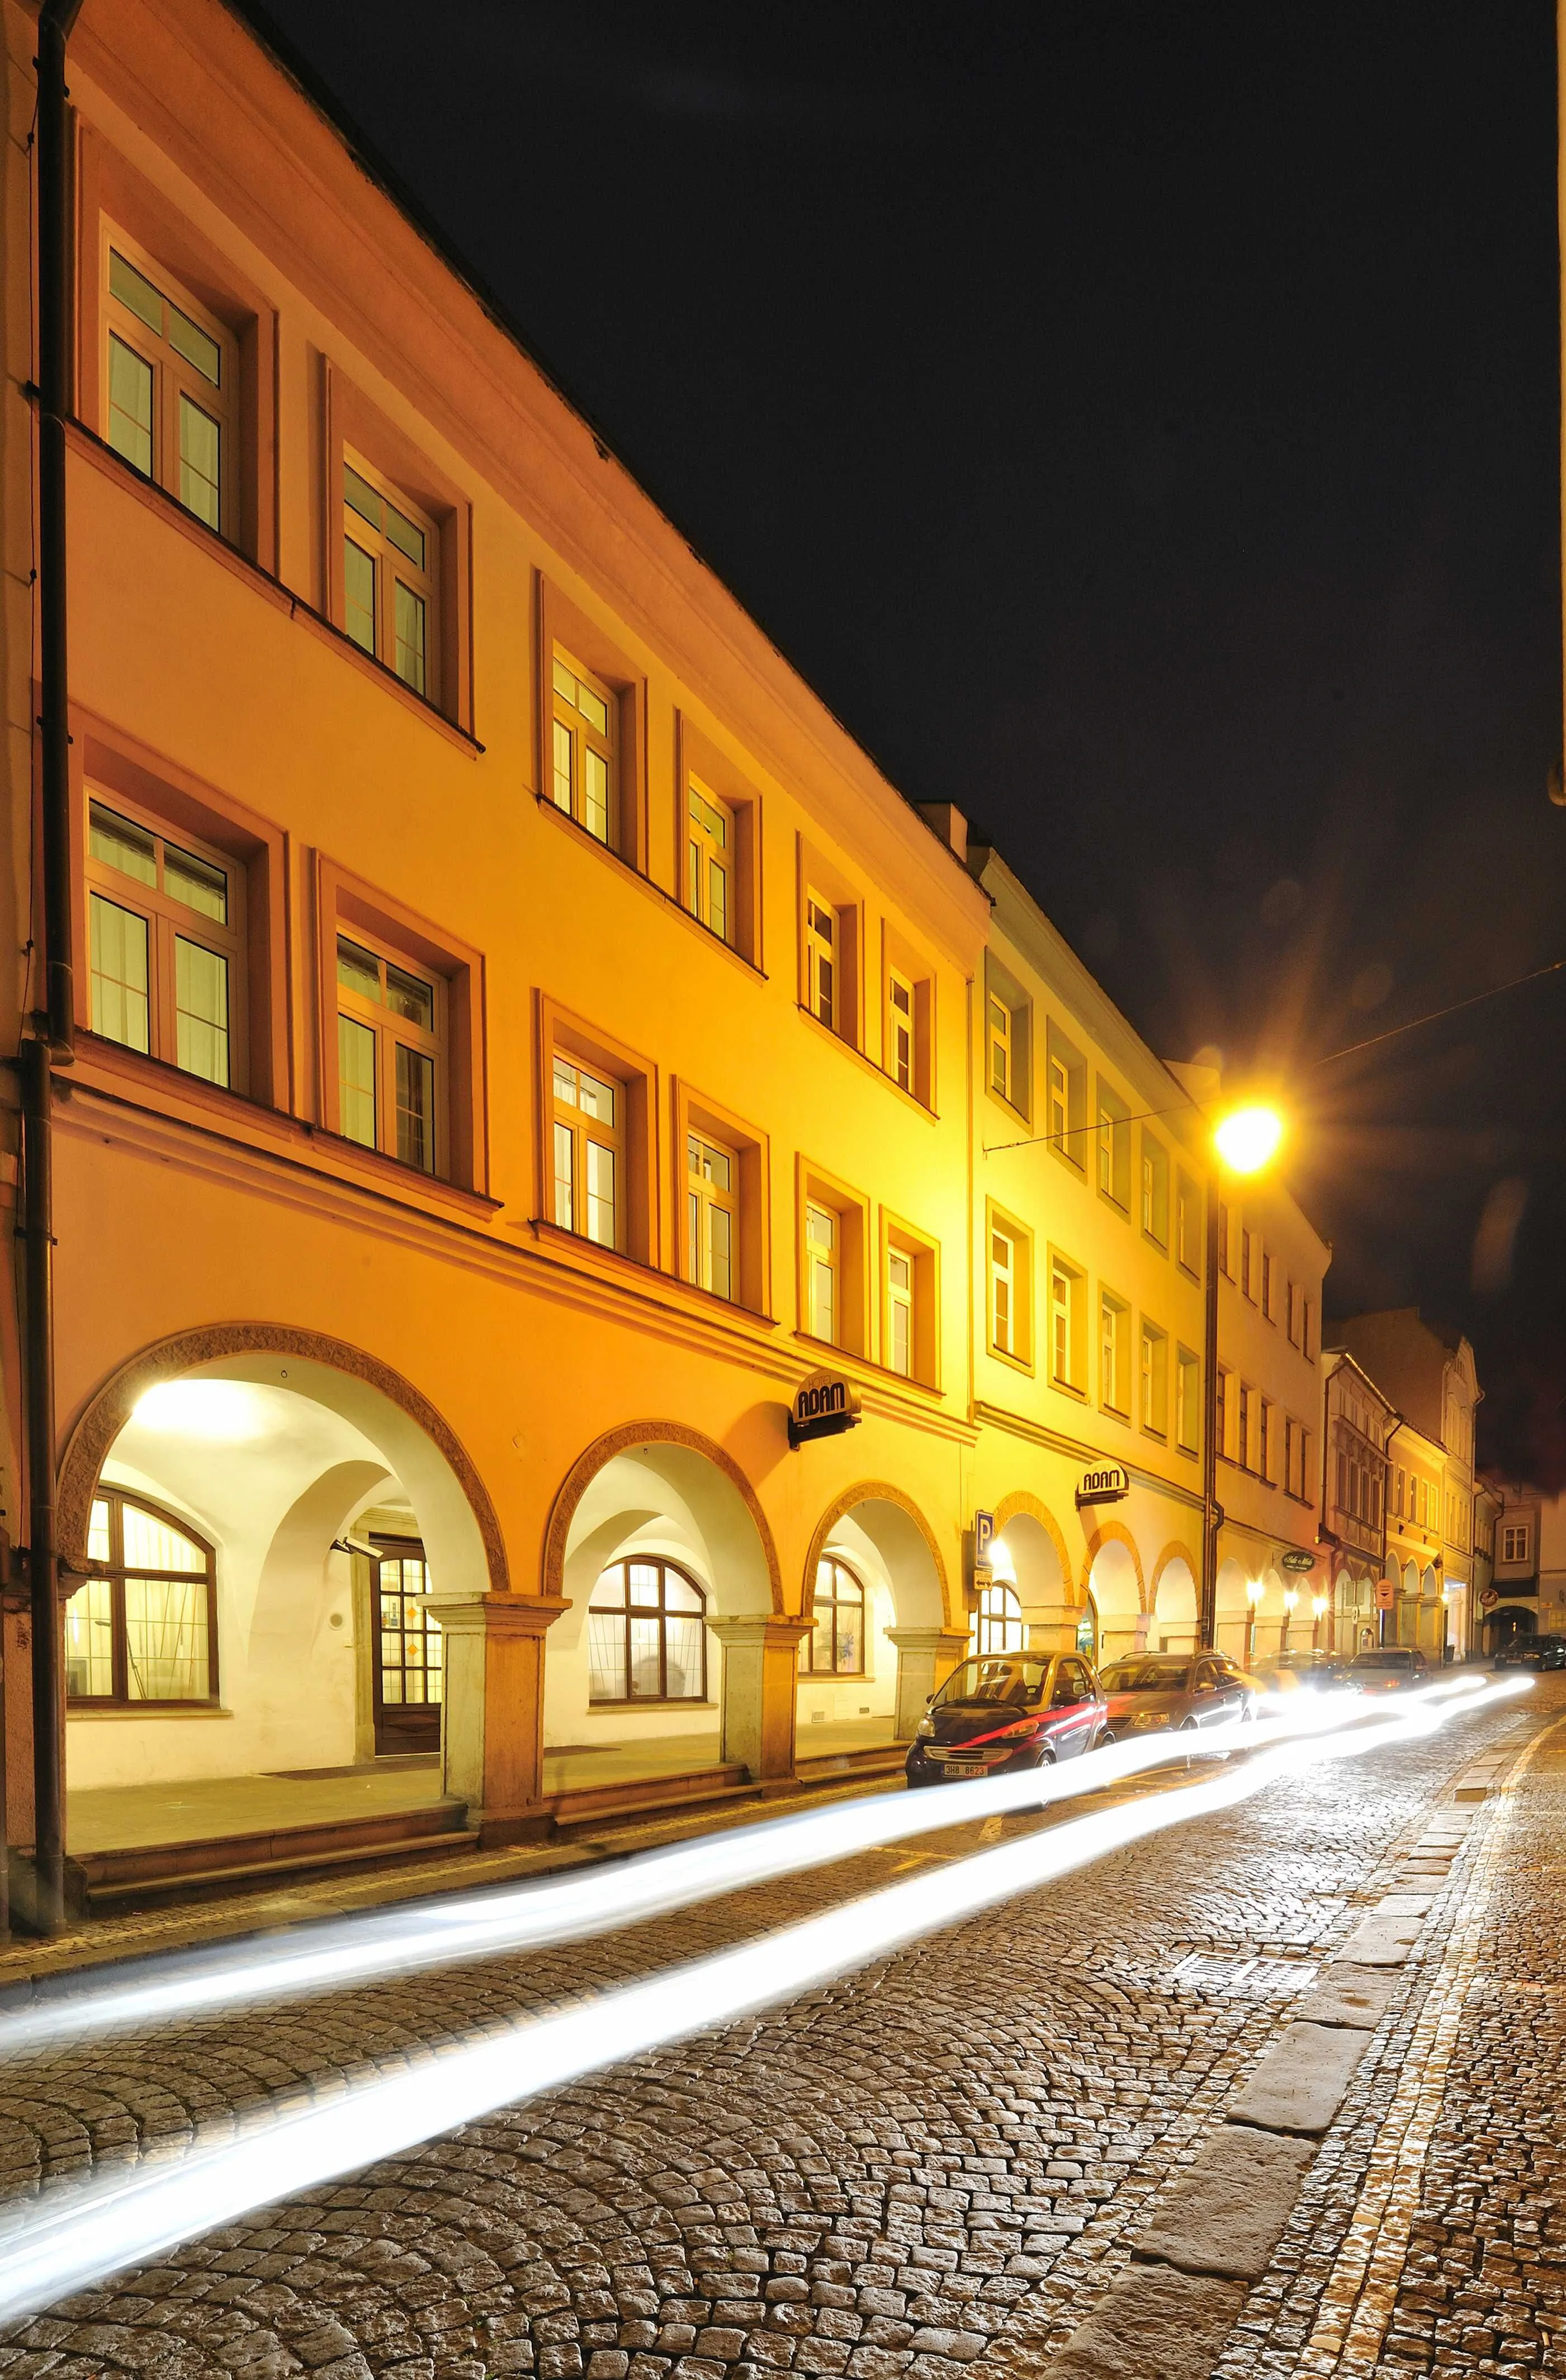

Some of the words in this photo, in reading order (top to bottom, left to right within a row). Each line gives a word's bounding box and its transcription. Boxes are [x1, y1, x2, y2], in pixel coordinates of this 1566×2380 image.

[808, 1374, 832, 1389] HOTEL
[798, 1382, 845, 1419] ADAM
[1084, 1470, 1120, 1491] ADAM
[980, 1519, 991, 1551] P
[965, 1766, 985, 1775] 8623
